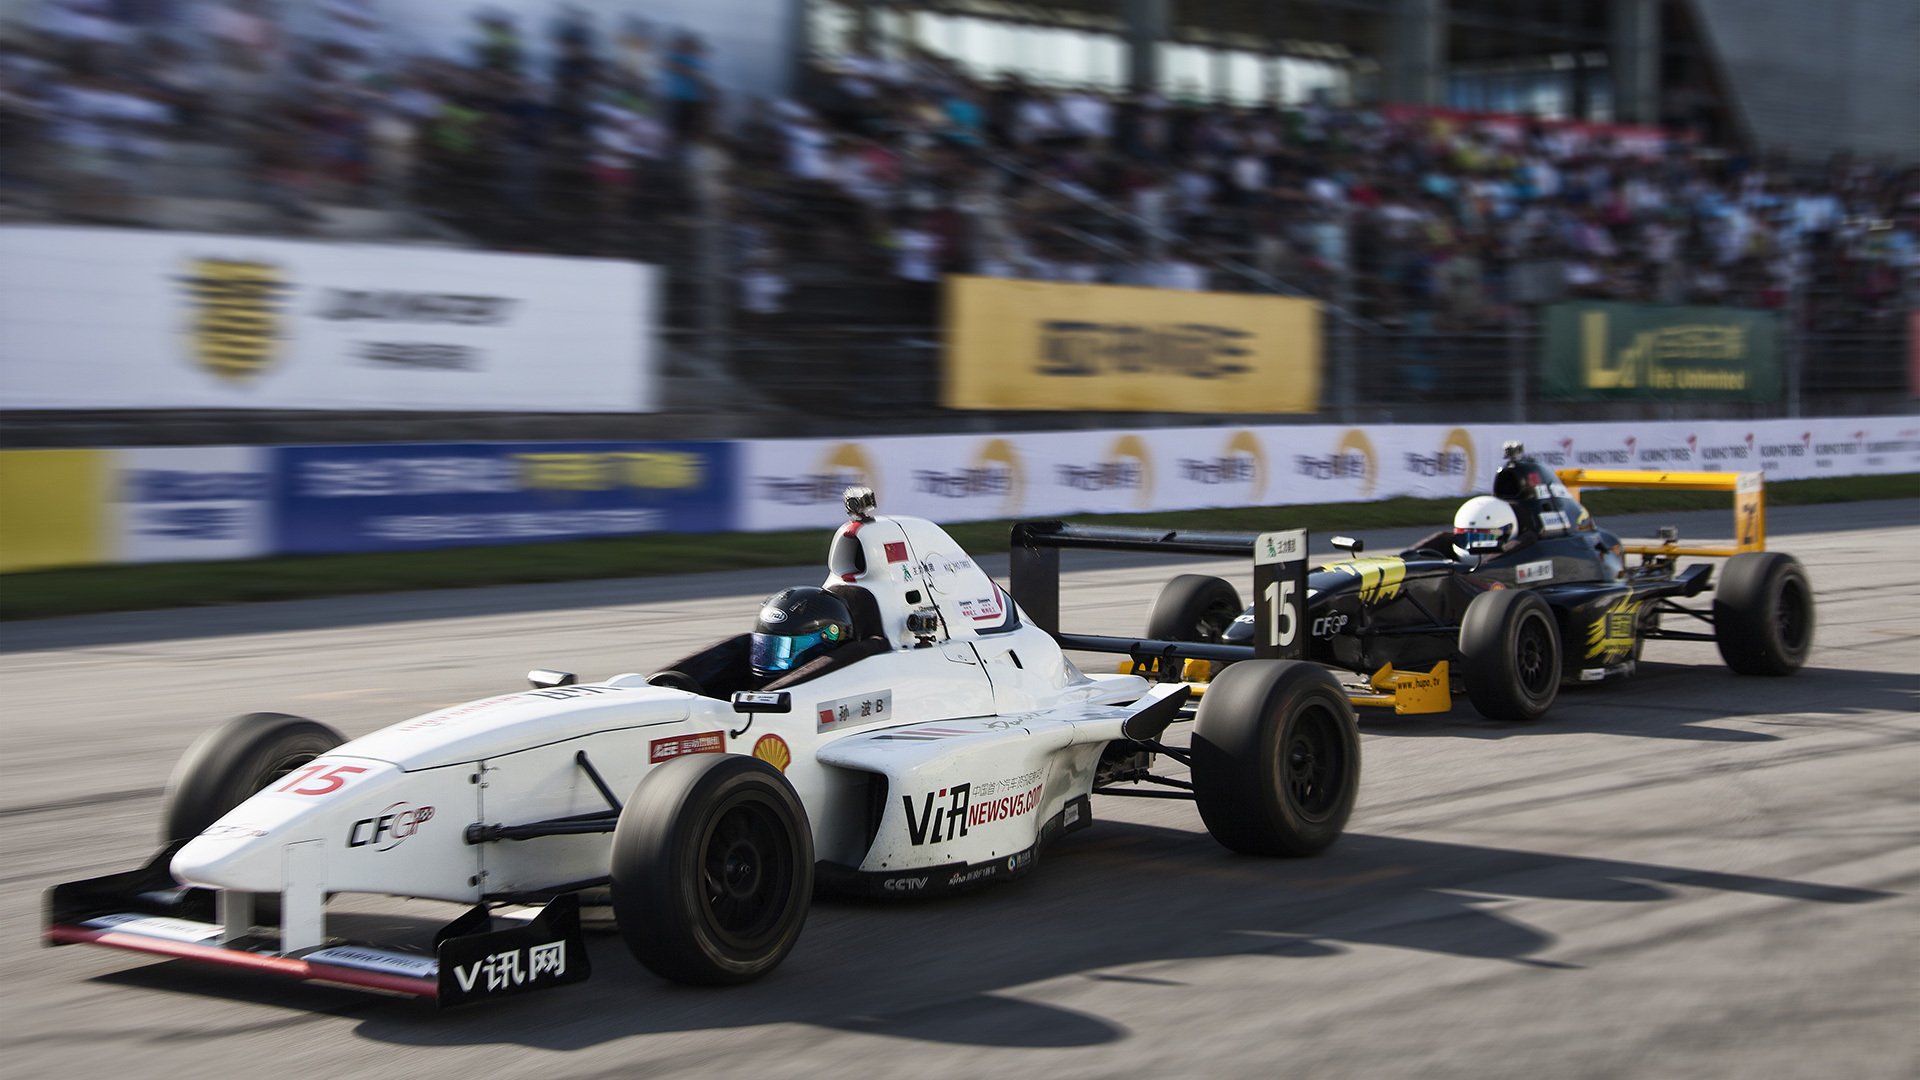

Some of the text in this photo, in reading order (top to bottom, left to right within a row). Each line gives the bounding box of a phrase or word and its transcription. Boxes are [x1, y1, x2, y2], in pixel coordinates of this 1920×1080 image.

[1264, 579, 1297, 647] 15
[875, 698, 884, 714] B
[276, 763, 368, 796] 15
[884, 876, 929, 891] CCTV
[453, 939, 567, 993] V讯网
